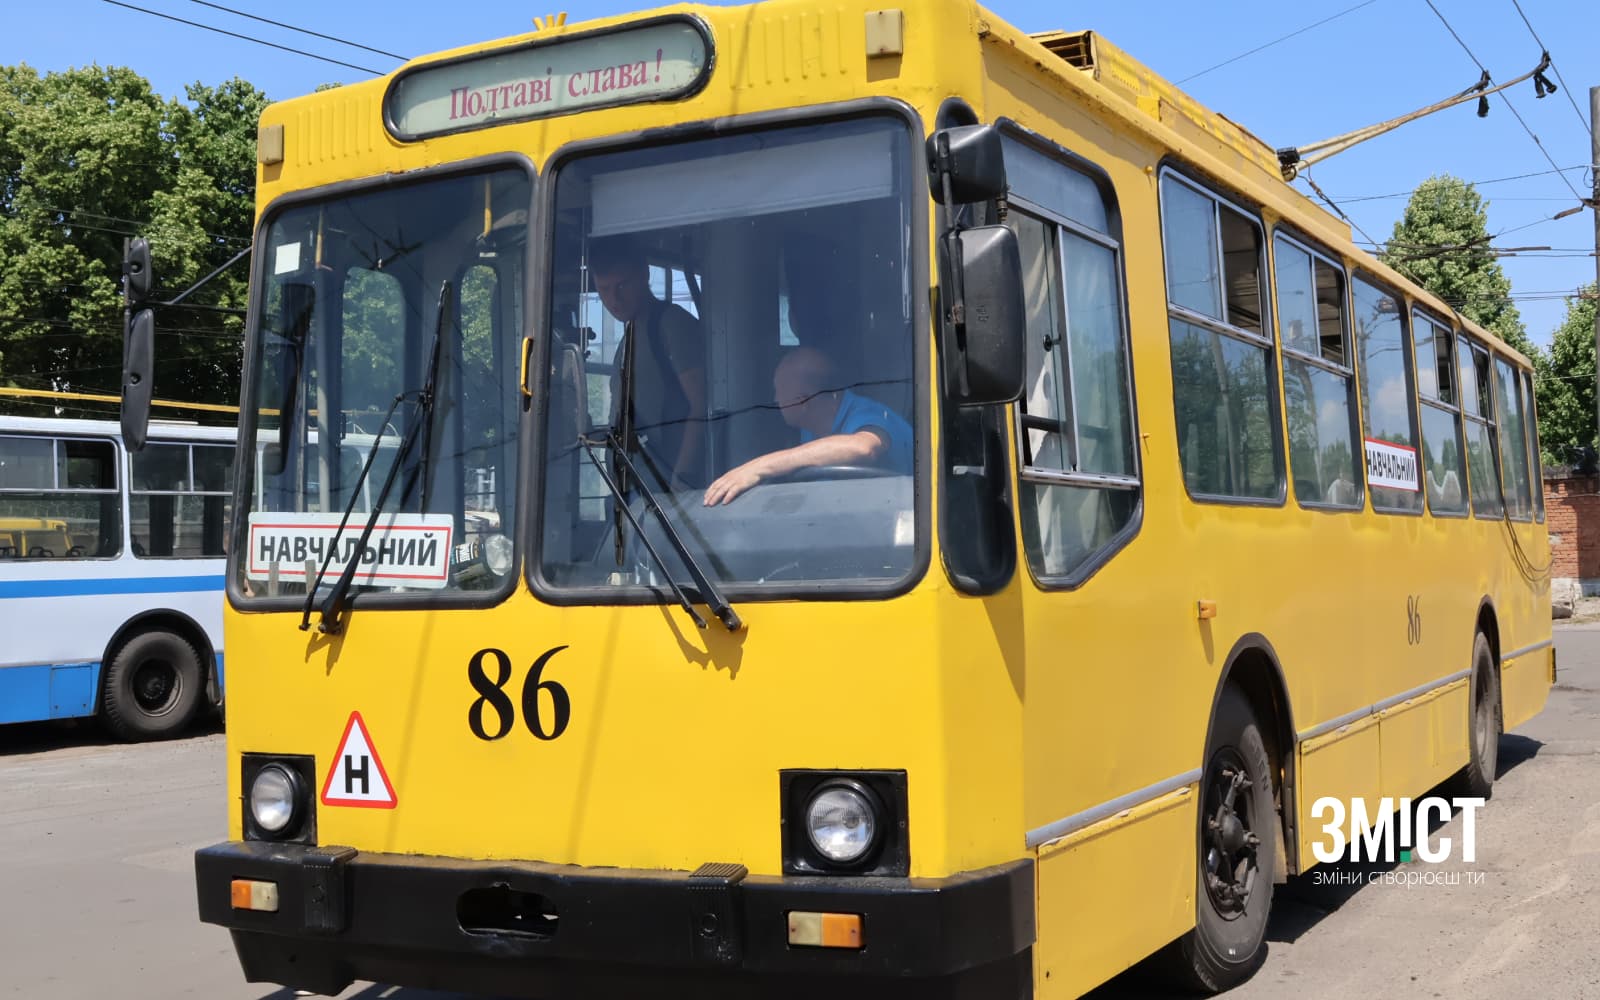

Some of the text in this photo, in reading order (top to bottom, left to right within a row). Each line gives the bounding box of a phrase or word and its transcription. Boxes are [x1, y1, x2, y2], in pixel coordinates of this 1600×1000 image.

[448, 48, 664, 120] Полтаві слава!
[259, 533, 438, 567] НАВЧАЛЬНИЙ
[1407, 594, 1421, 646] 86
[467, 644, 571, 742] 86
